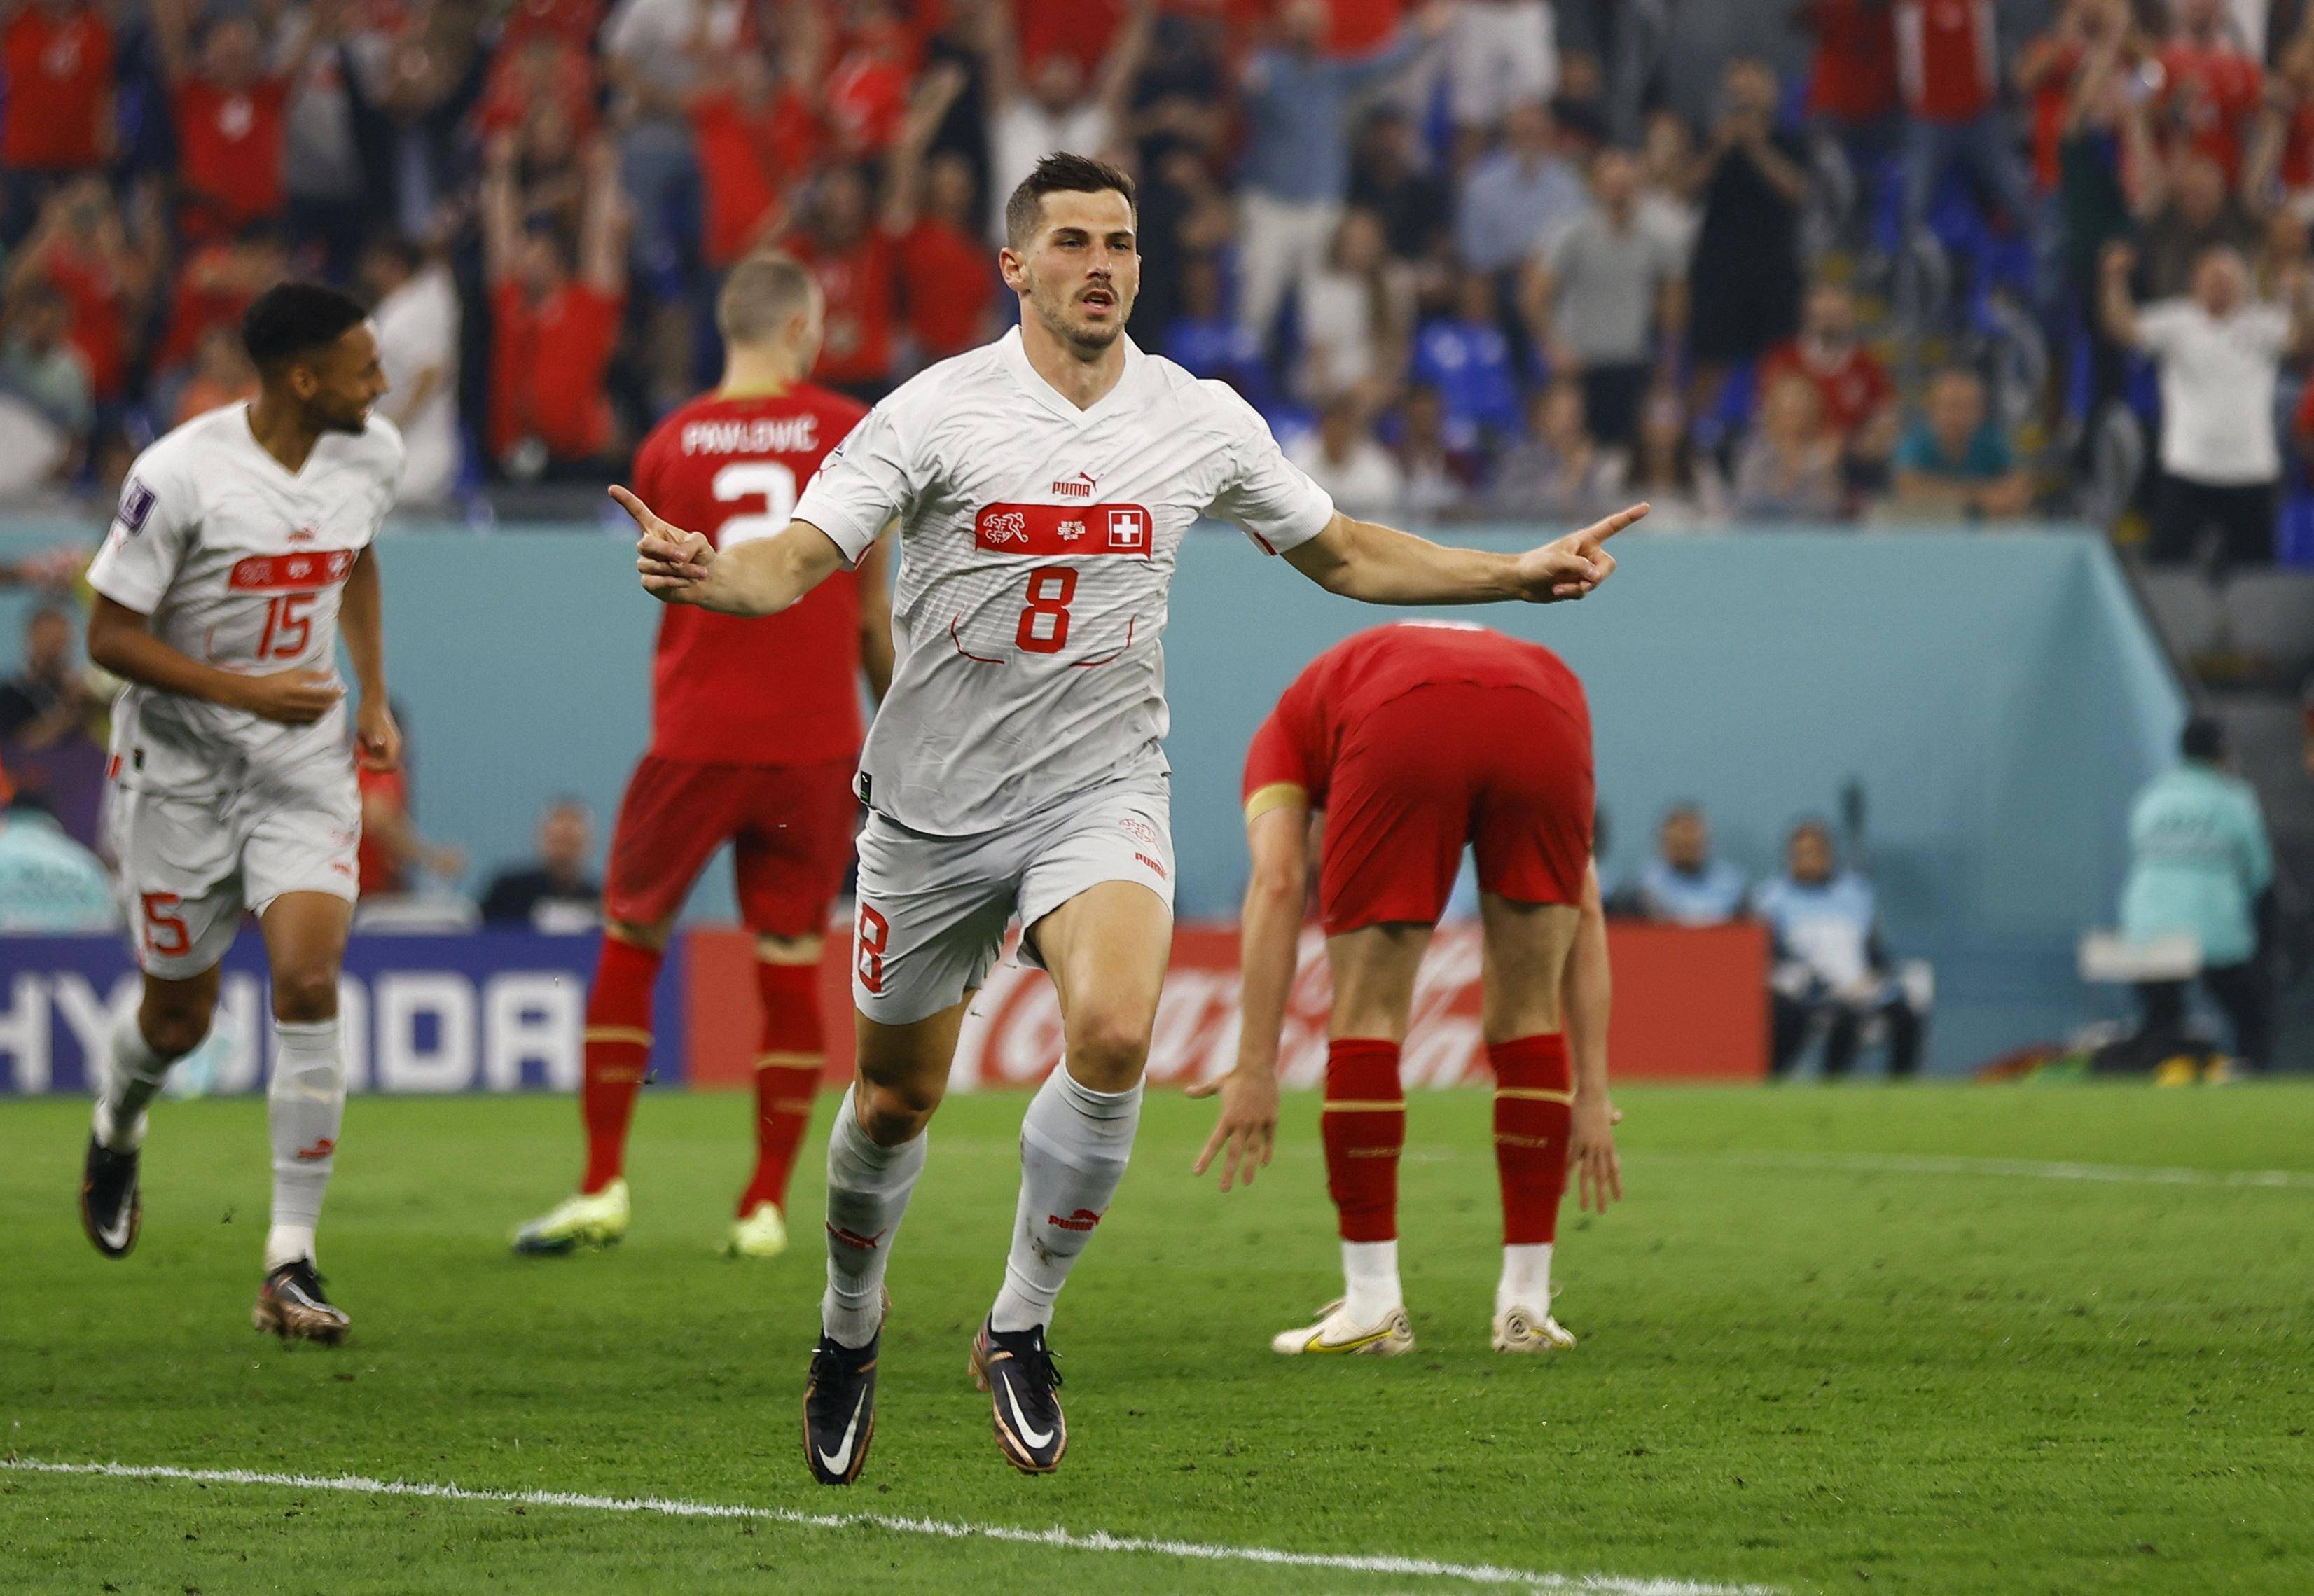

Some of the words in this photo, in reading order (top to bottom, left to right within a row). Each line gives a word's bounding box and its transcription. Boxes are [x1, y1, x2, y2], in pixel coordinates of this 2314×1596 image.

[713, 461, 795, 552] 2
[1052, 482, 1090, 497] PUMA
[256, 594, 316, 660] 15
[1015, 567, 1079, 654] 8
[857, 902, 889, 994] 8
